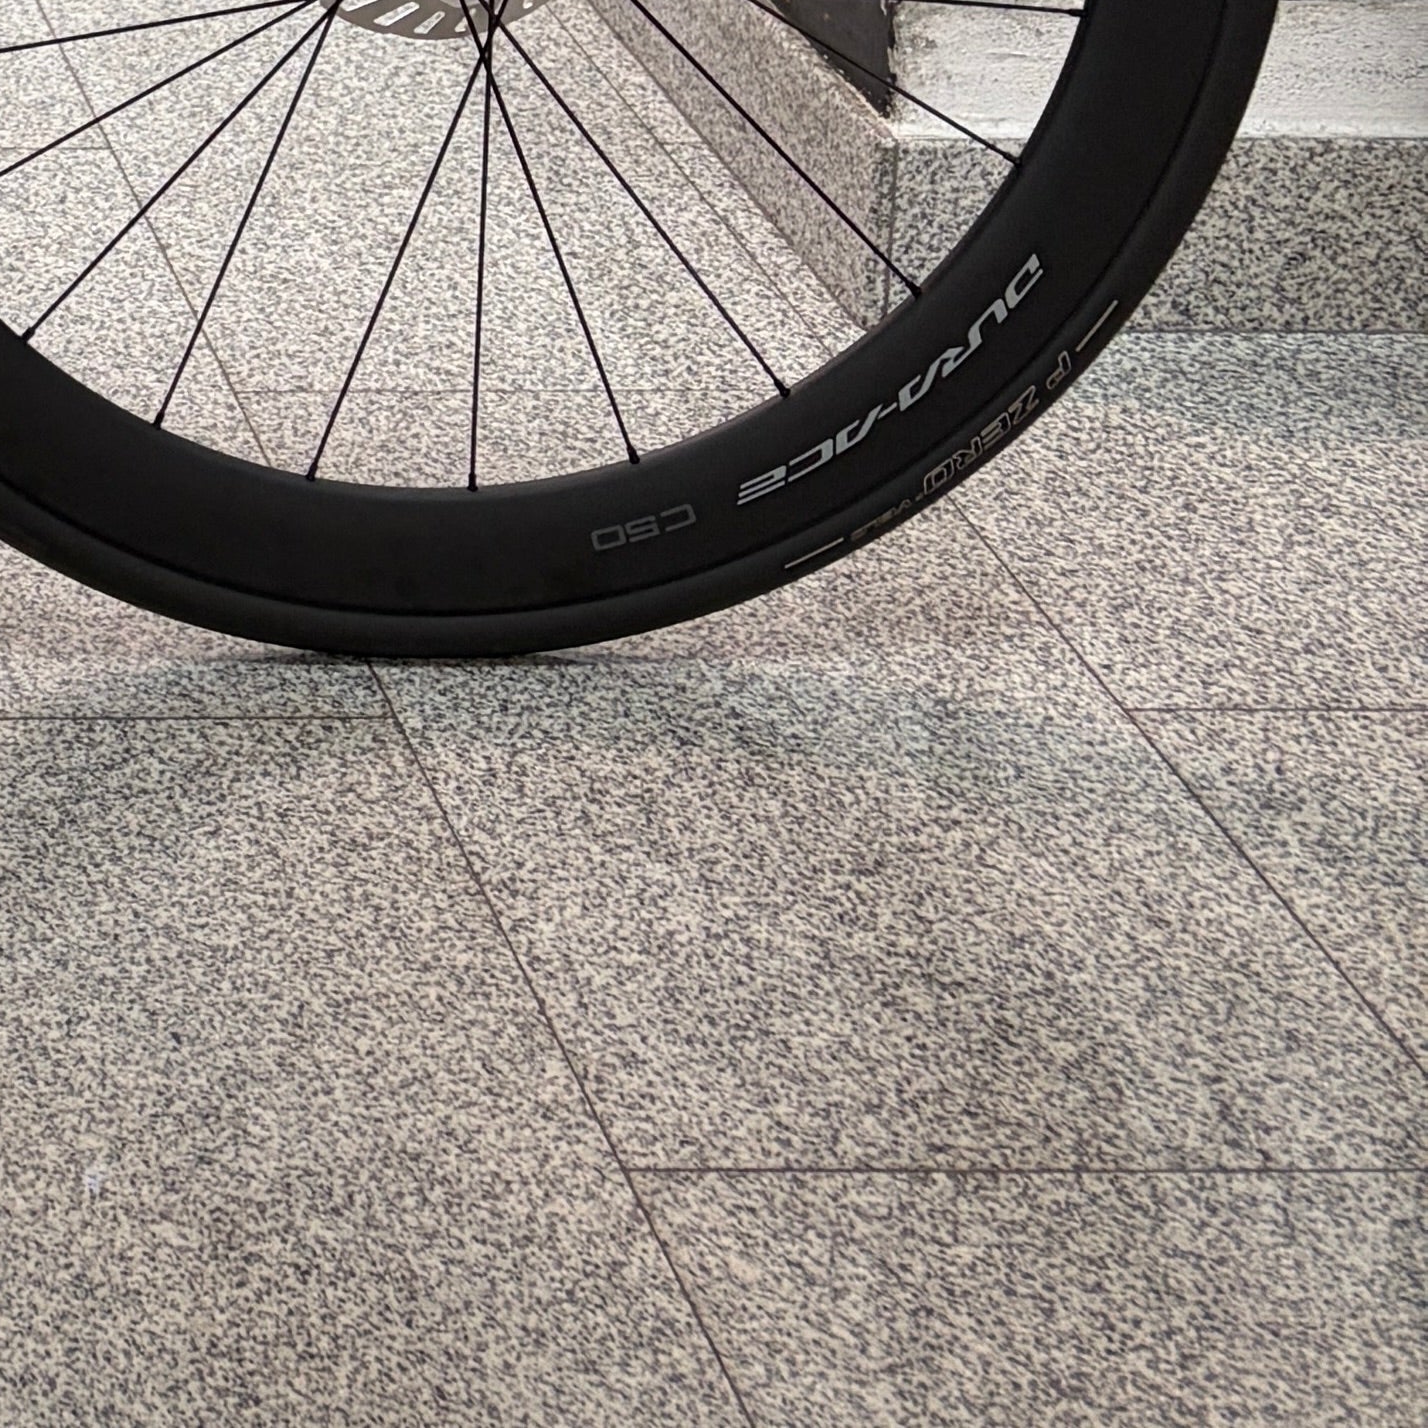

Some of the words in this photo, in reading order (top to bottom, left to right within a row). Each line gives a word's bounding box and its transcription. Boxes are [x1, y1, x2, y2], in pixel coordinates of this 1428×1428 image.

[737, 253, 1045, 505] DURA-ACE
[923, 385, 1040, 495] ZERO
[591, 503, 696, 552] C50
